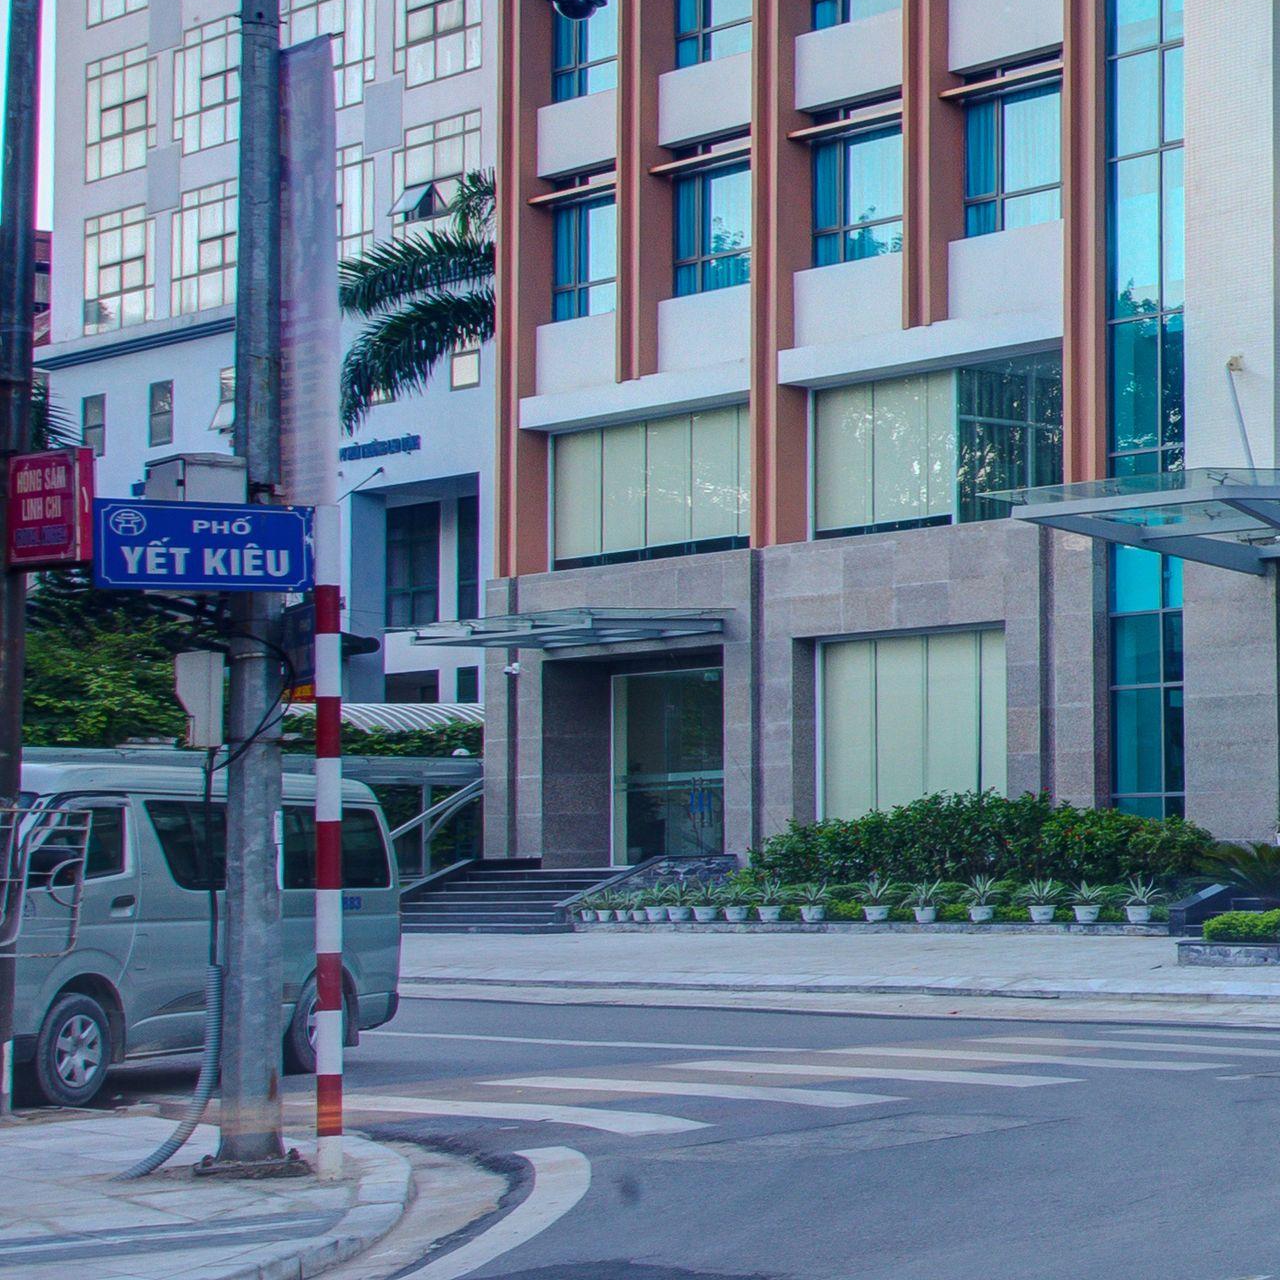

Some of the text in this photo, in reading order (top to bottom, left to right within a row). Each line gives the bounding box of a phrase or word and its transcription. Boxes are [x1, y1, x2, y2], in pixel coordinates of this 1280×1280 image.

[21, 497, 43, 521] LINH
[192, 516, 252, 535] PHỐ
[120, 537, 290, 577] YẾT KIÊU
